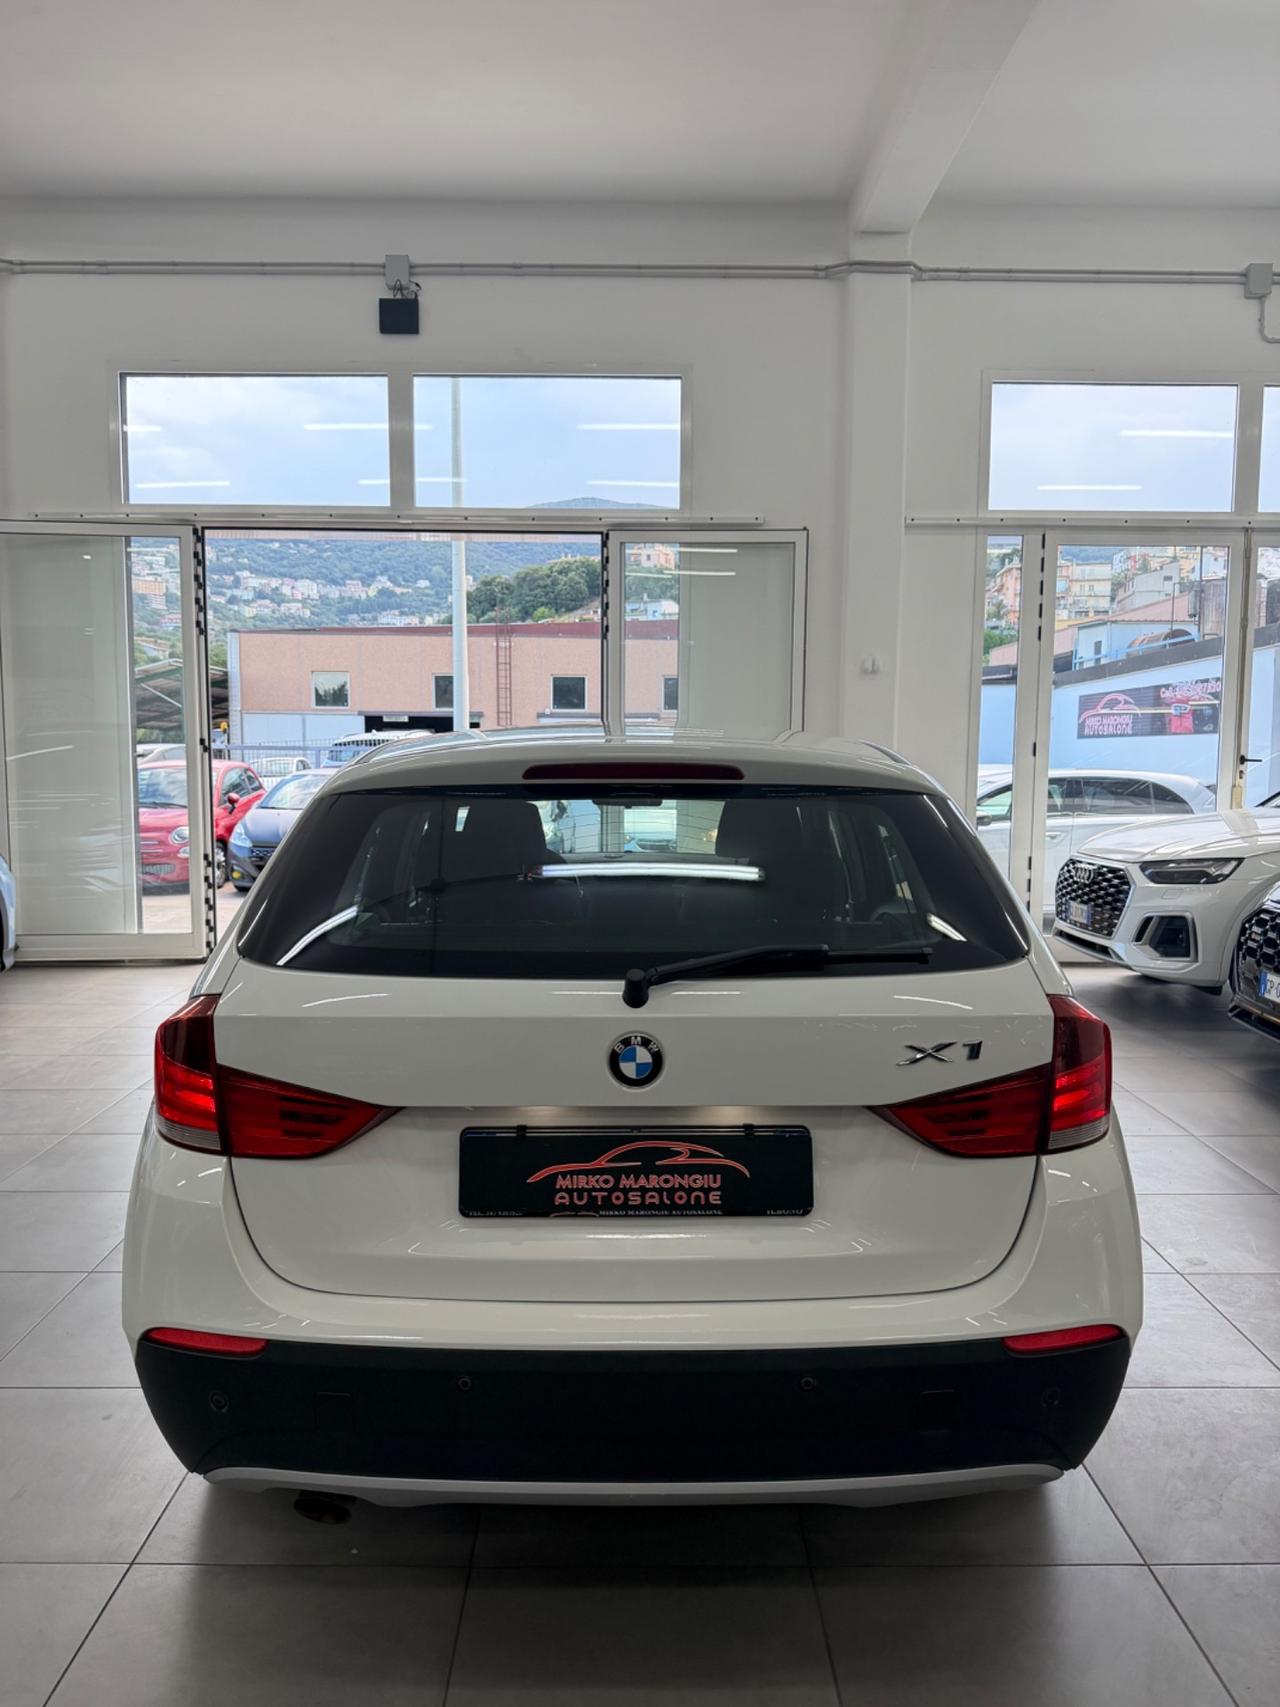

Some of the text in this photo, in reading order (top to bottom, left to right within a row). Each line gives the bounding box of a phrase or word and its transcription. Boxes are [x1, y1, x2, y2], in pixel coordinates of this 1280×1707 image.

[896, 1040, 983, 1066] X1
[555, 1174, 721, 1189] MIRKO MARONGIU
[554, 1191, 722, 1205] AUTOSALONE
